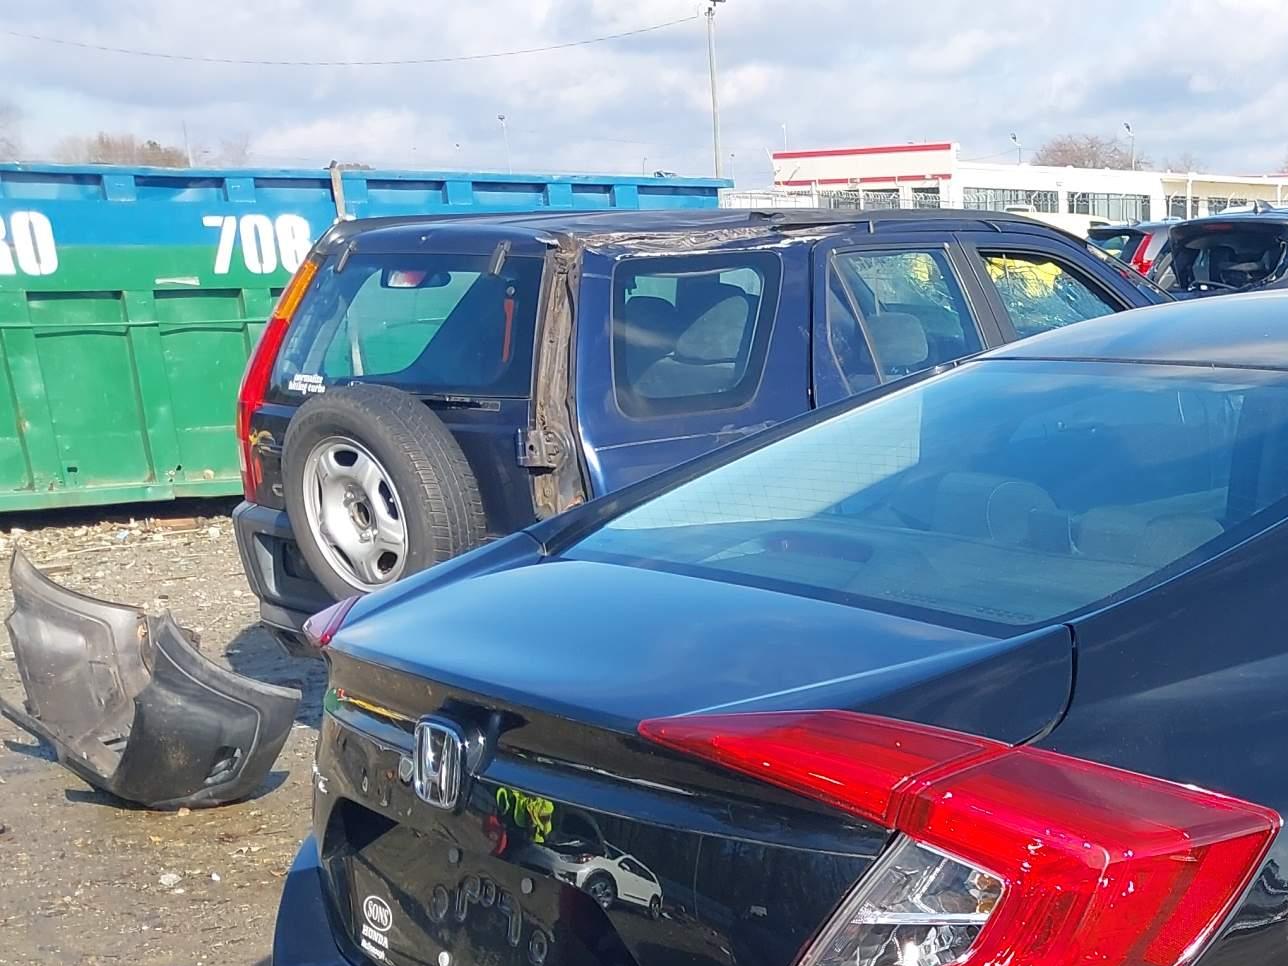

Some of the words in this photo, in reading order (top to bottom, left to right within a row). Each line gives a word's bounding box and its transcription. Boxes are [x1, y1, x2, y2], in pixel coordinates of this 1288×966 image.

[202, 213, 312, 275] 708
[367, 900, 389, 927] SONS
[361, 923, 389, 950] HONDA
